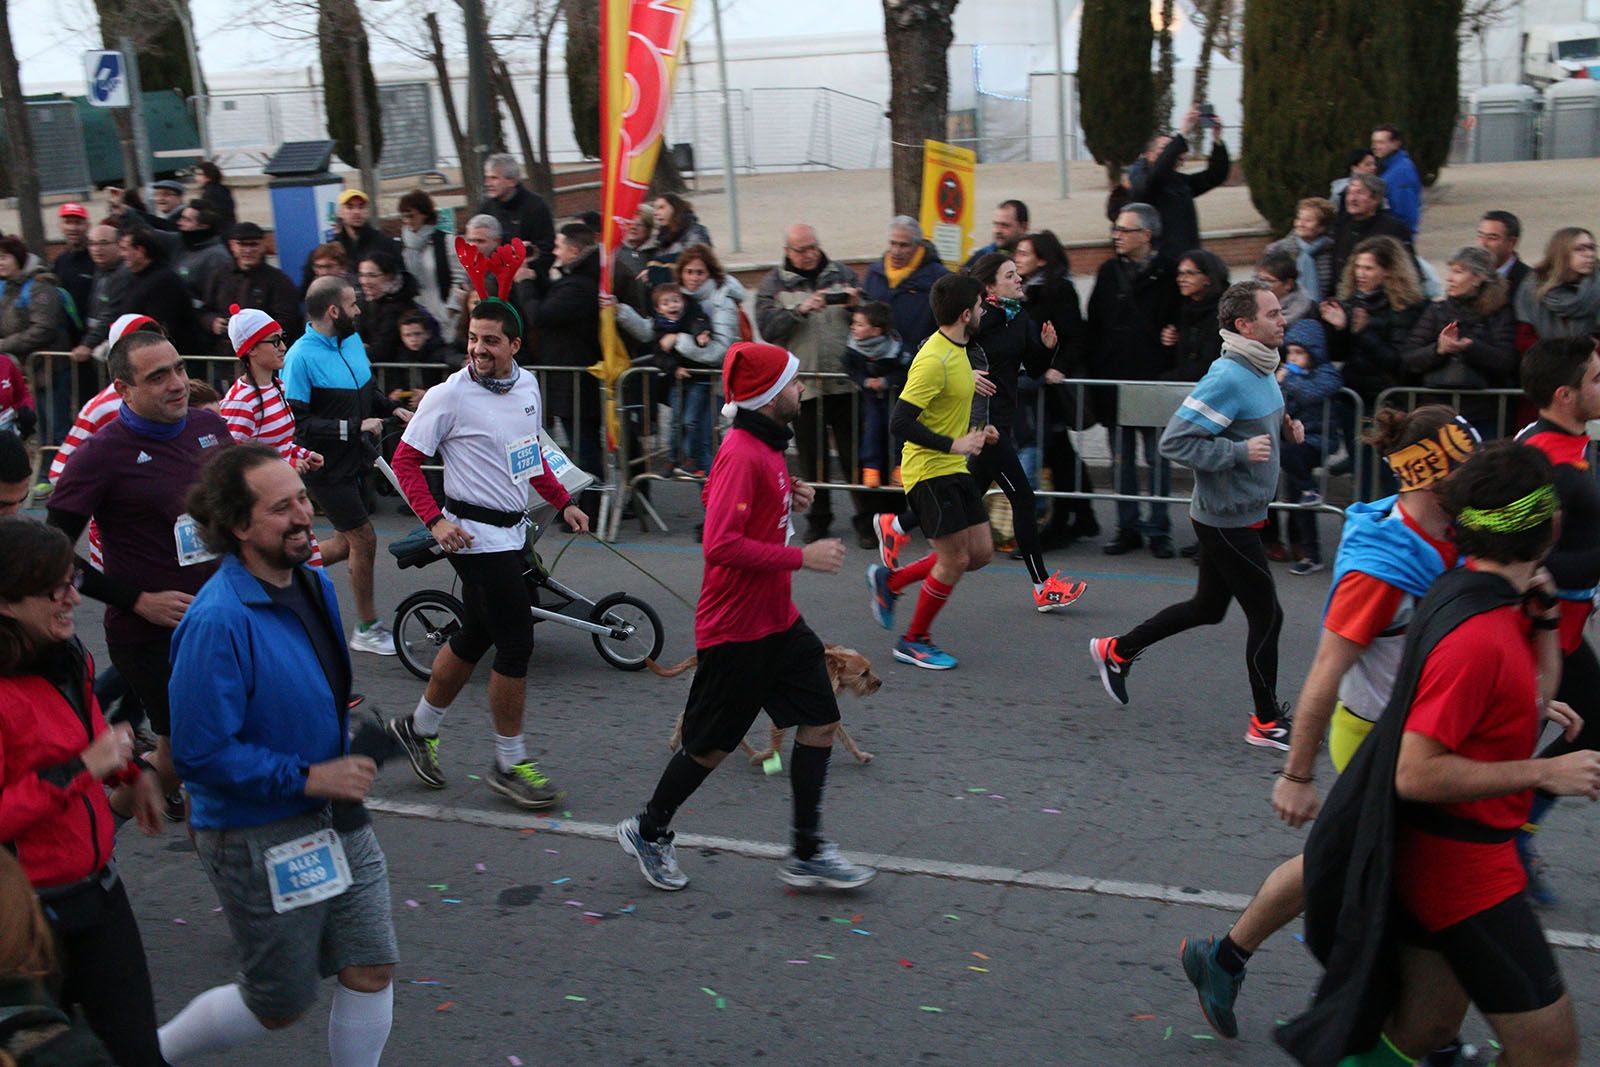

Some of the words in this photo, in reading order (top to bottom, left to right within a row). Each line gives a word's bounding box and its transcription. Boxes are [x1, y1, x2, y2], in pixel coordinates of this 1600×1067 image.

[516, 446, 534, 459] CESC
[516, 456, 535, 470] 1787
[288, 851, 321, 873] ALEX
